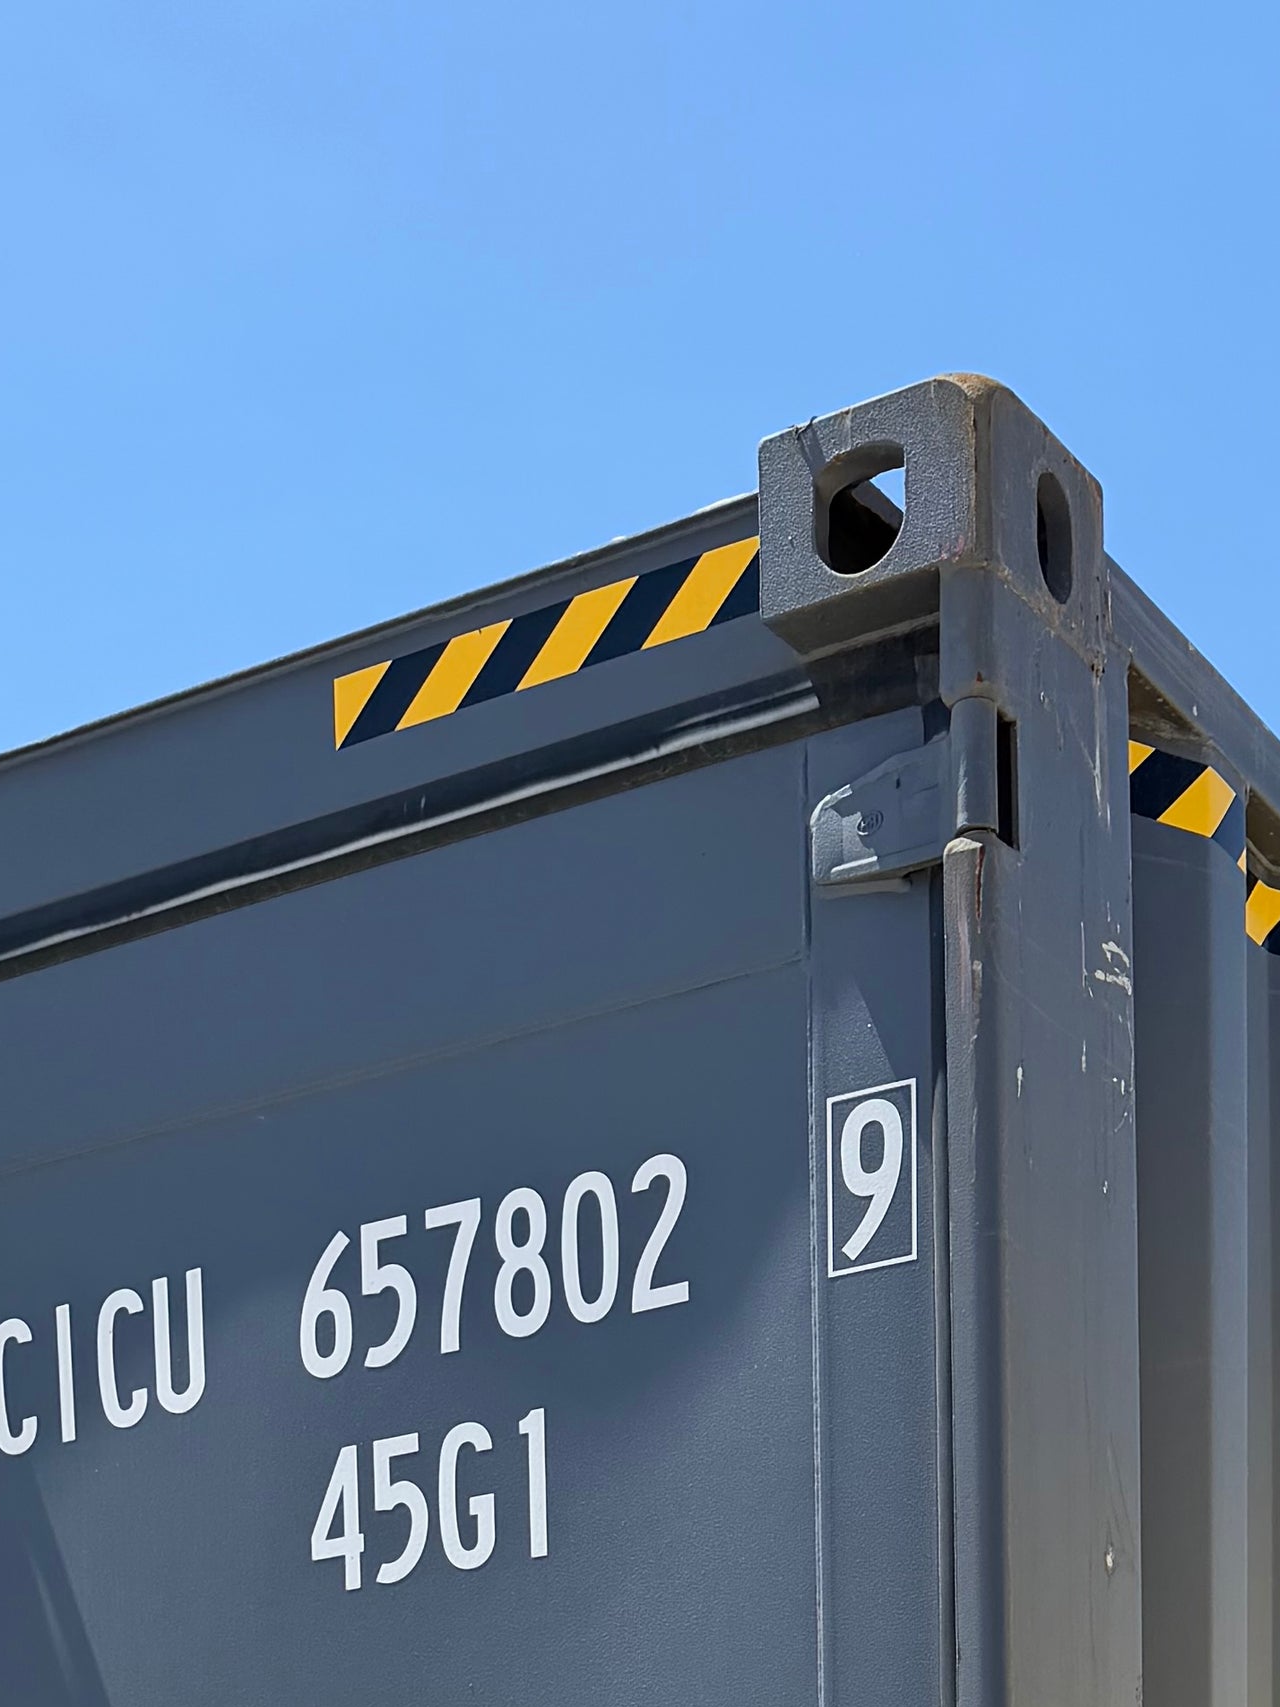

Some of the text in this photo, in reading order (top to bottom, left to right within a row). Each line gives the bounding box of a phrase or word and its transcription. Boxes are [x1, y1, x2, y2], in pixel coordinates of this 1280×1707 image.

[298, 1152, 691, 1380] 657802
[839, 1096, 904, 1262] 9
[309, 1406, 549, 1592] 45G1
